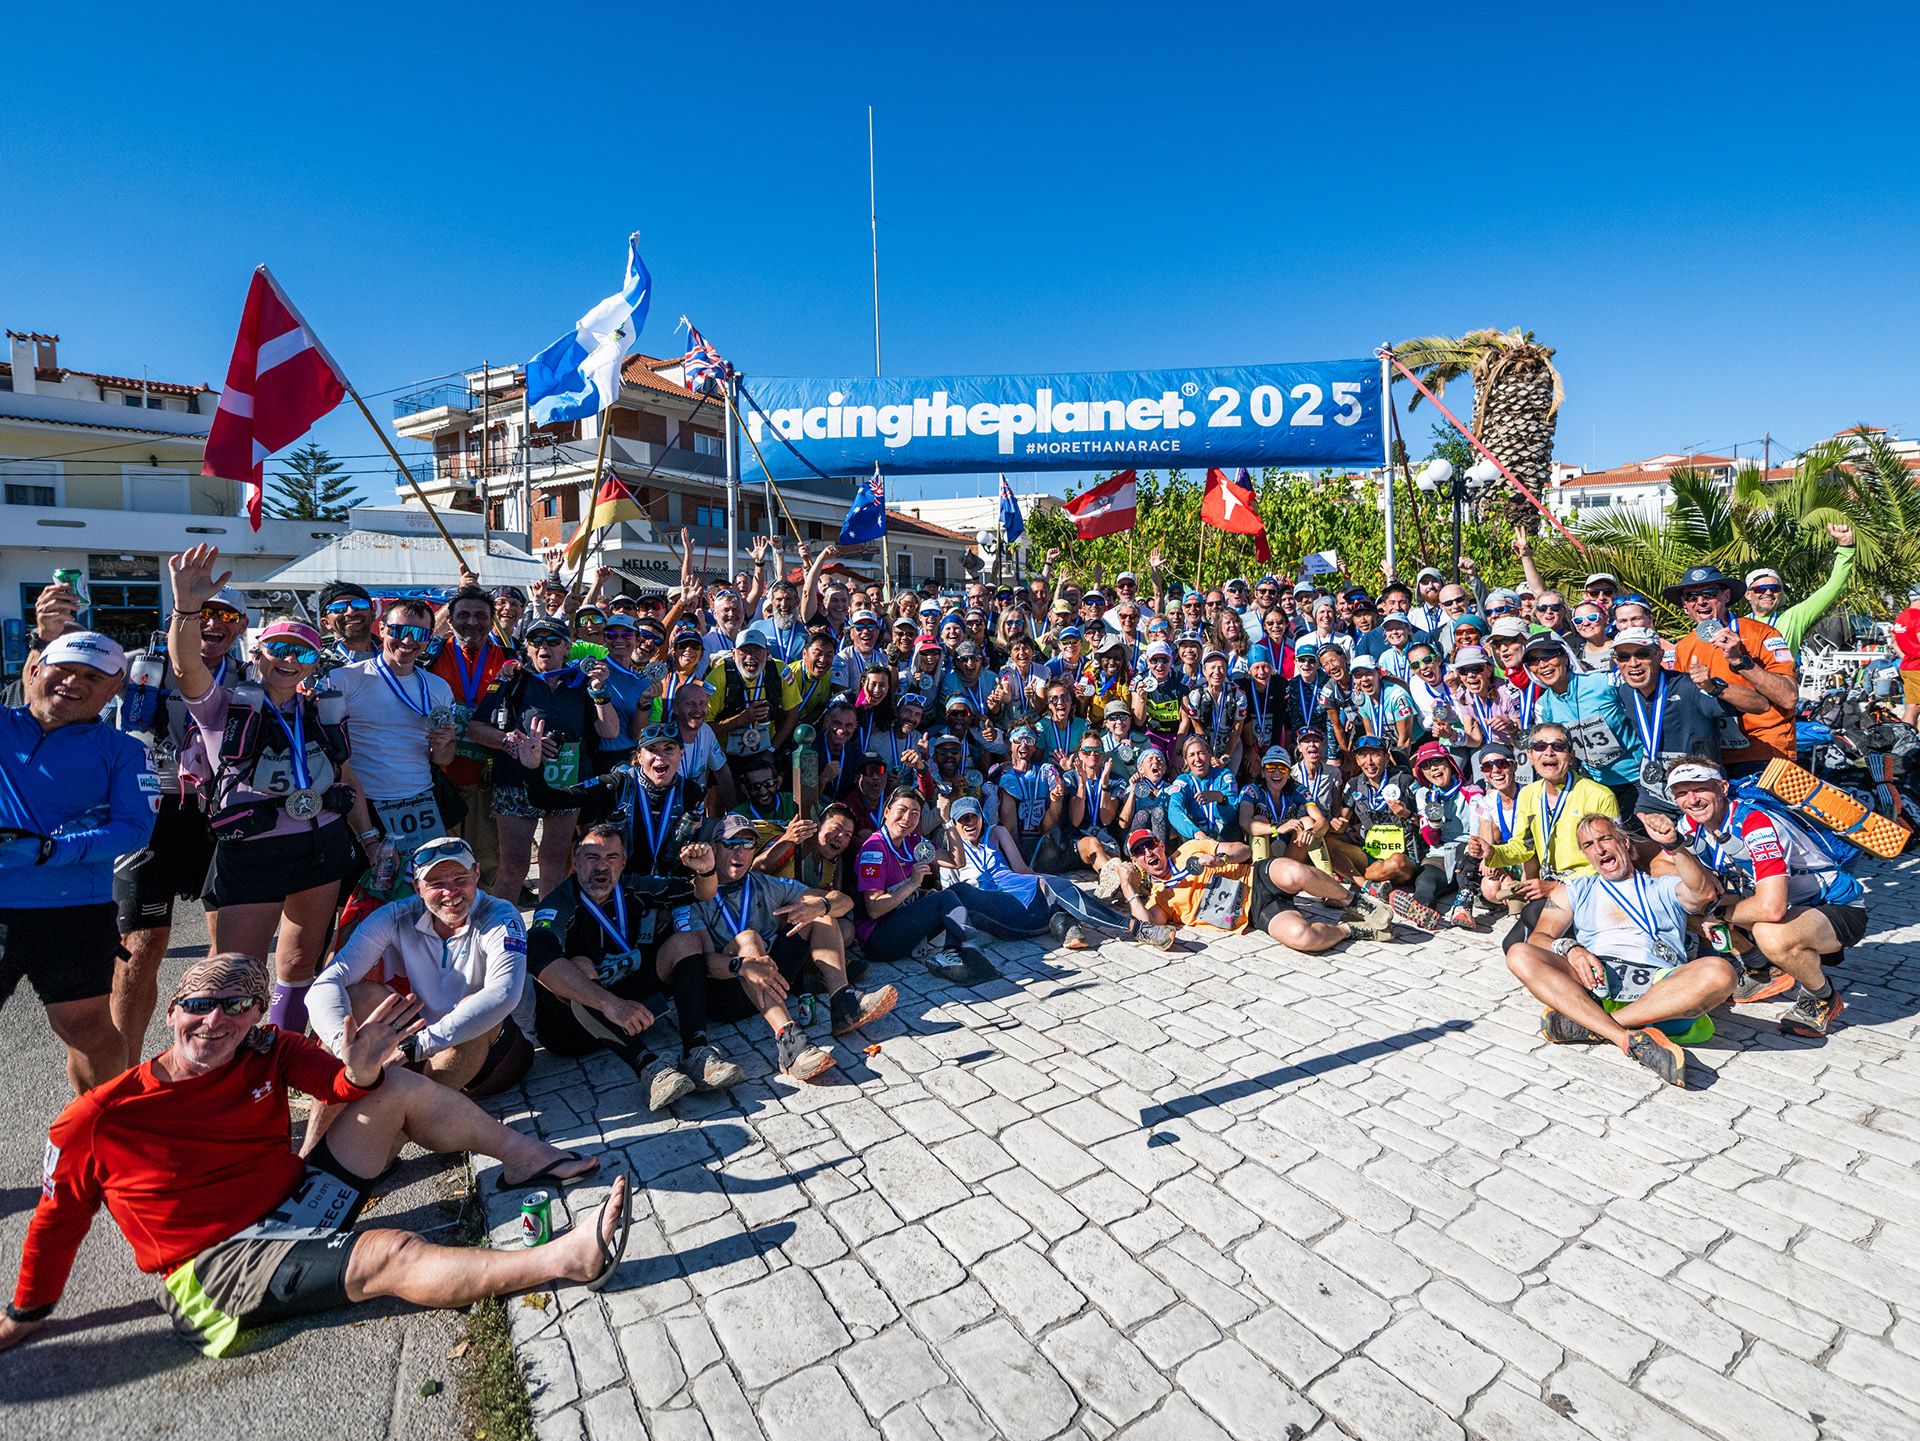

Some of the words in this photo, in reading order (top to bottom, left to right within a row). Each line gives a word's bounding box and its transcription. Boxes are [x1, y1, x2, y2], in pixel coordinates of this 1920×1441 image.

[1207, 382, 1363, 428] 2025
[1025, 439, 1181, 454] #MORETHANARACE
[622, 558, 669, 570] MELLOS
[389, 809, 436, 834] 105
[1366, 841, 1402, 850] LEADER
[307, 1182, 331, 1209] Dean
[522, 1215, 535, 1231] A
